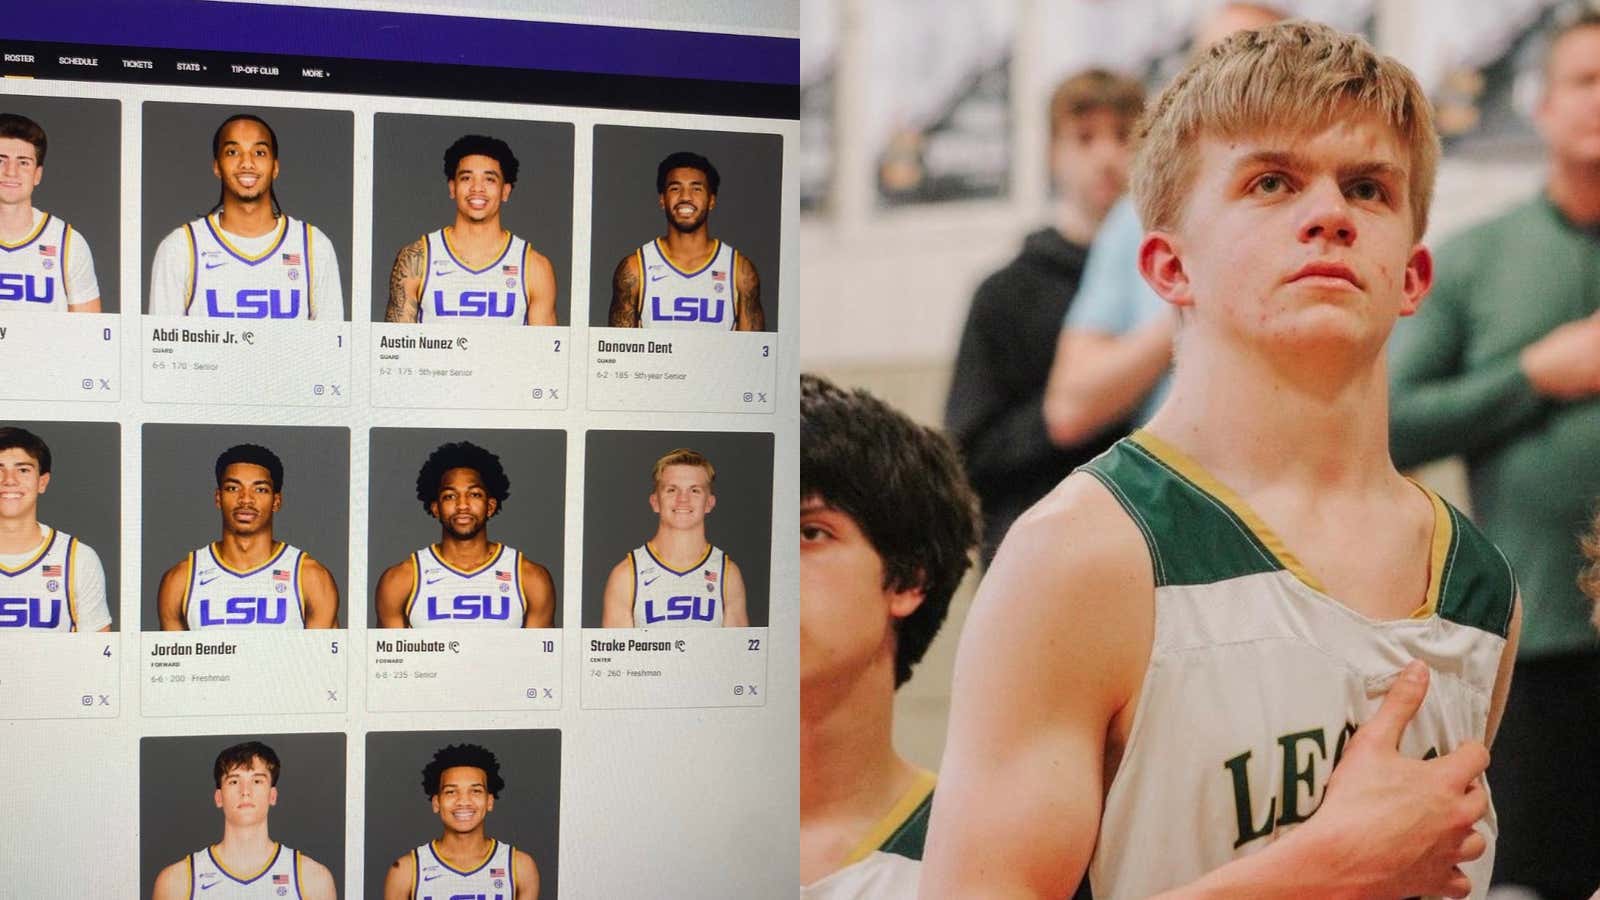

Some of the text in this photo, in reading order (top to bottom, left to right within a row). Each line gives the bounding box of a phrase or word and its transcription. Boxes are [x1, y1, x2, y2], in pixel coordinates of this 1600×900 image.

[4, 54, 35, 64] ROSTER
[58, 57, 99, 67] SCHEDULE
[122, 60, 153, 70] TICKETS
[176, 62, 200, 72] STATS
[231, 65, 279, 76] TIP-OFF CLUB
[302, 69, 324, 79] MORE
[0, 273, 55, 304] SU
[206, 289, 301, 319] LSU
[434, 290, 516, 318] LSU
[651, 296, 726, 323] LSU
[103, 328, 112, 342] 0
[152, 328, 239, 345] Abdi Bashir Jr.
[337, 335, 343, 348] 1
[380, 335, 453, 350] Austin Nunez
[553, 340, 561, 352] 2
[598, 340, 674, 356] Donovan Dent
[762, 345, 770, 358] 3
[193, 362, 219, 372] Senior
[449, 370, 473, 378] Senior
[664, 373, 688, 381] Senior
[0, 598, 62, 629] SU
[199, 597, 287, 627] LSU
[427, 595, 511, 622] LSU
[644, 596, 717, 624] LSU
[103, 645, 112, 658] 4
[151, 642, 238, 656] Jordan Bender
[331, 642, 339, 654] 5
[542, 640, 554, 653] 10
[628, 640, 672, 652] Pearson
[748, 639, 760, 651] 22
[191, 673, 231, 682] Freshman
[414, 671, 438, 679] Senior
[627, 669, 662, 678] Freshman
